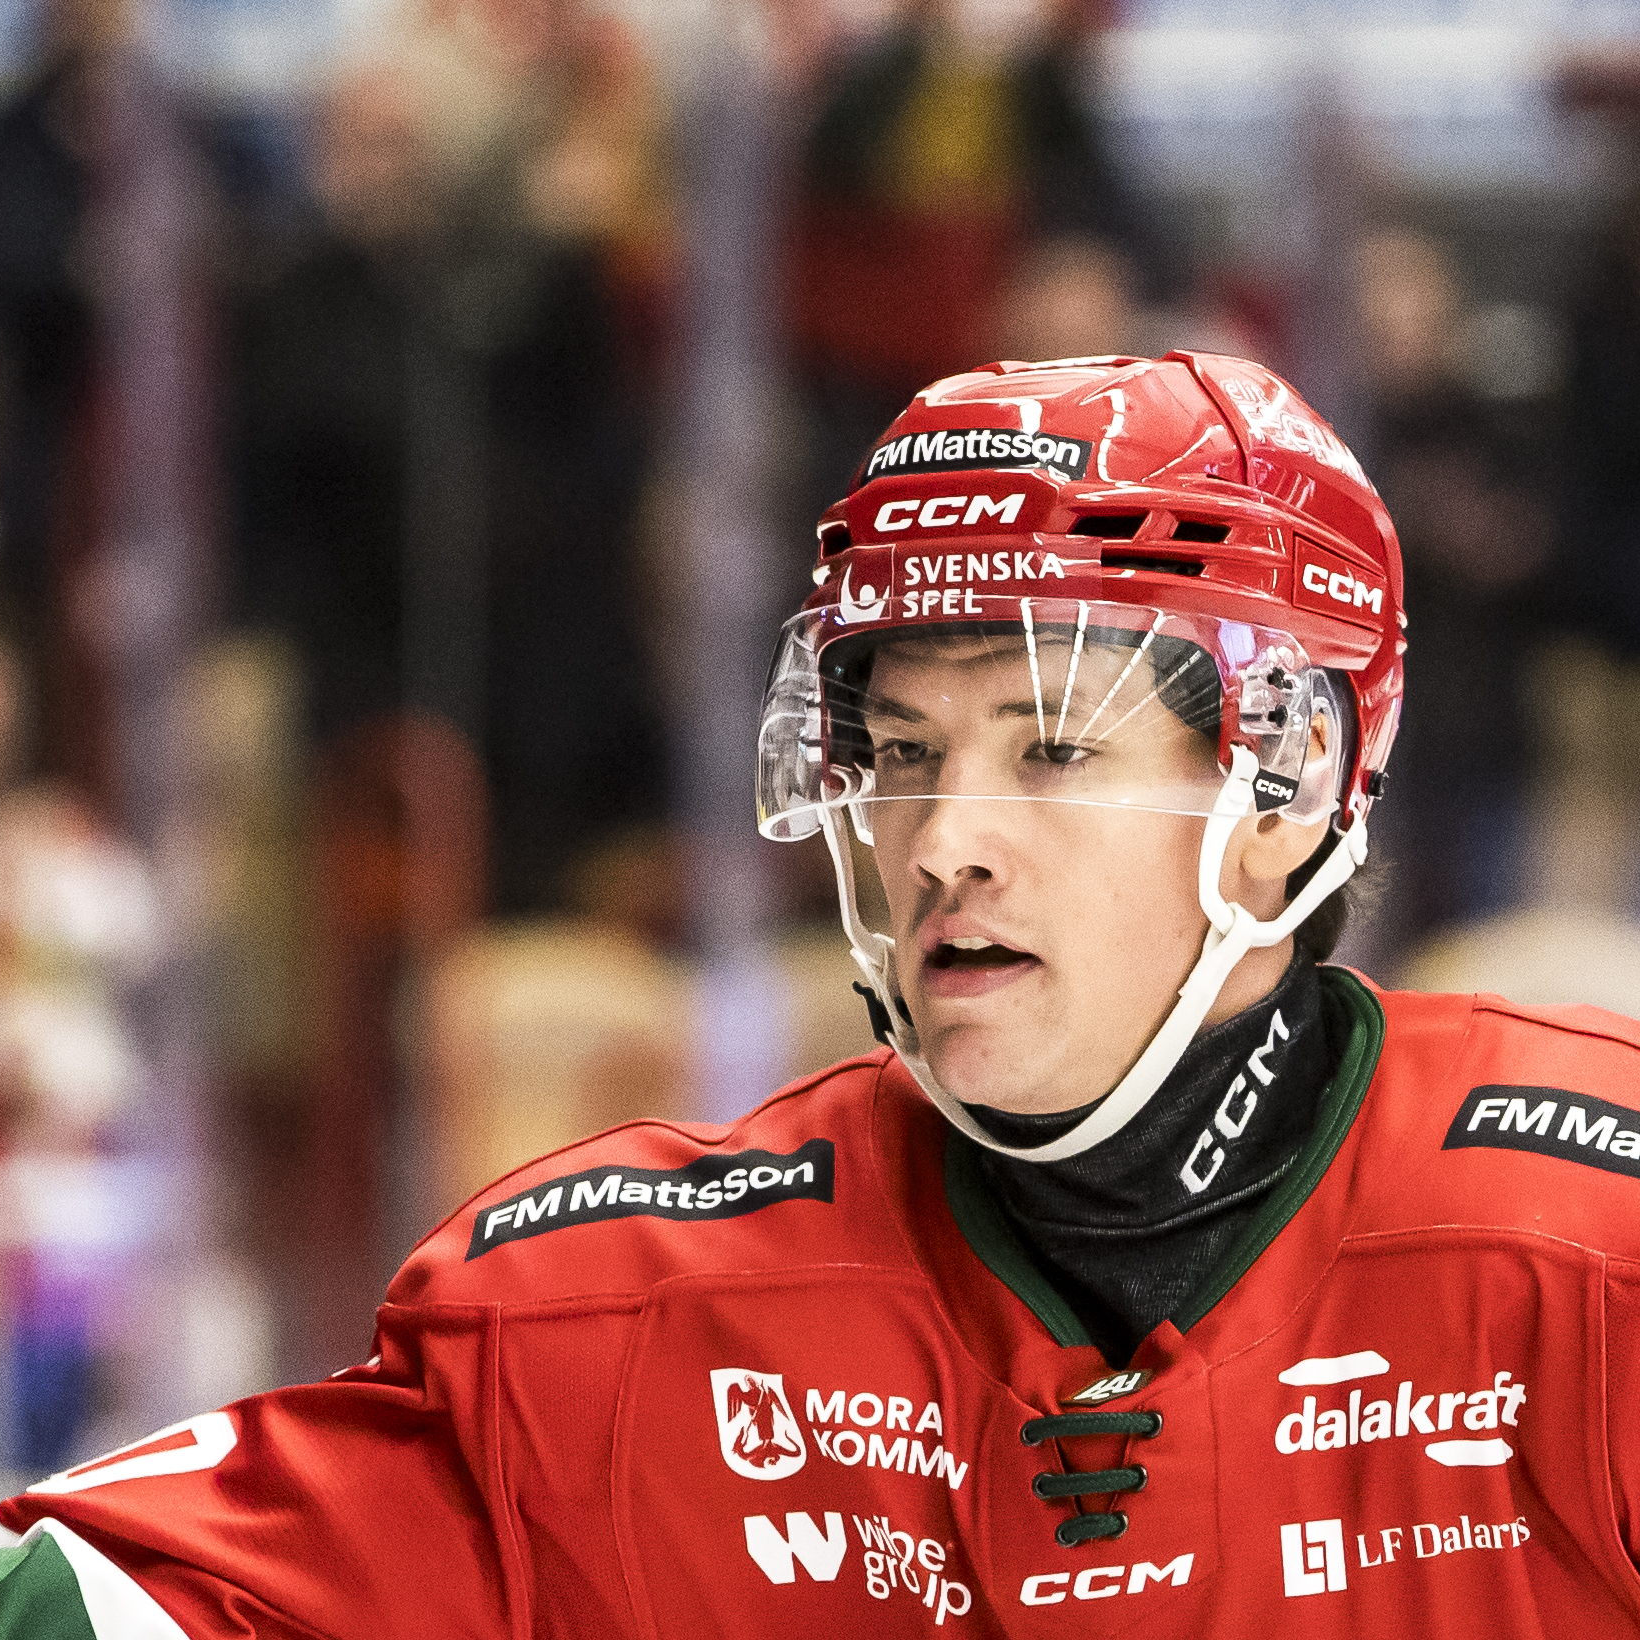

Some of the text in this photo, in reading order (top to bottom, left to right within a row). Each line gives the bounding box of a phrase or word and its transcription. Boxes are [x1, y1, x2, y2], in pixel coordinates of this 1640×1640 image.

[867, 430, 1081, 476] FM Mattsson
[873, 494, 1026, 532] CCM
[904, 551, 1065, 587] SVENSKA
[1302, 563, 1383, 615] CCM
[902, 587, 983, 618] SPEL
[1256, 779, 1294, 801] CCM
[1179, 1008, 1291, 1195] CCM
[1467, 1096, 1557, 1137] FM
[483, 1160, 815, 1240] FM Mattsson
[806, 1388, 943, 1436] MORA
[1274, 1370, 1527, 1455] dalakraft
[812, 1428, 969, 1491] KOMMN
[1356, 1527, 1404, 1568] LF
[1018, 1552, 1196, 1607] CCM
